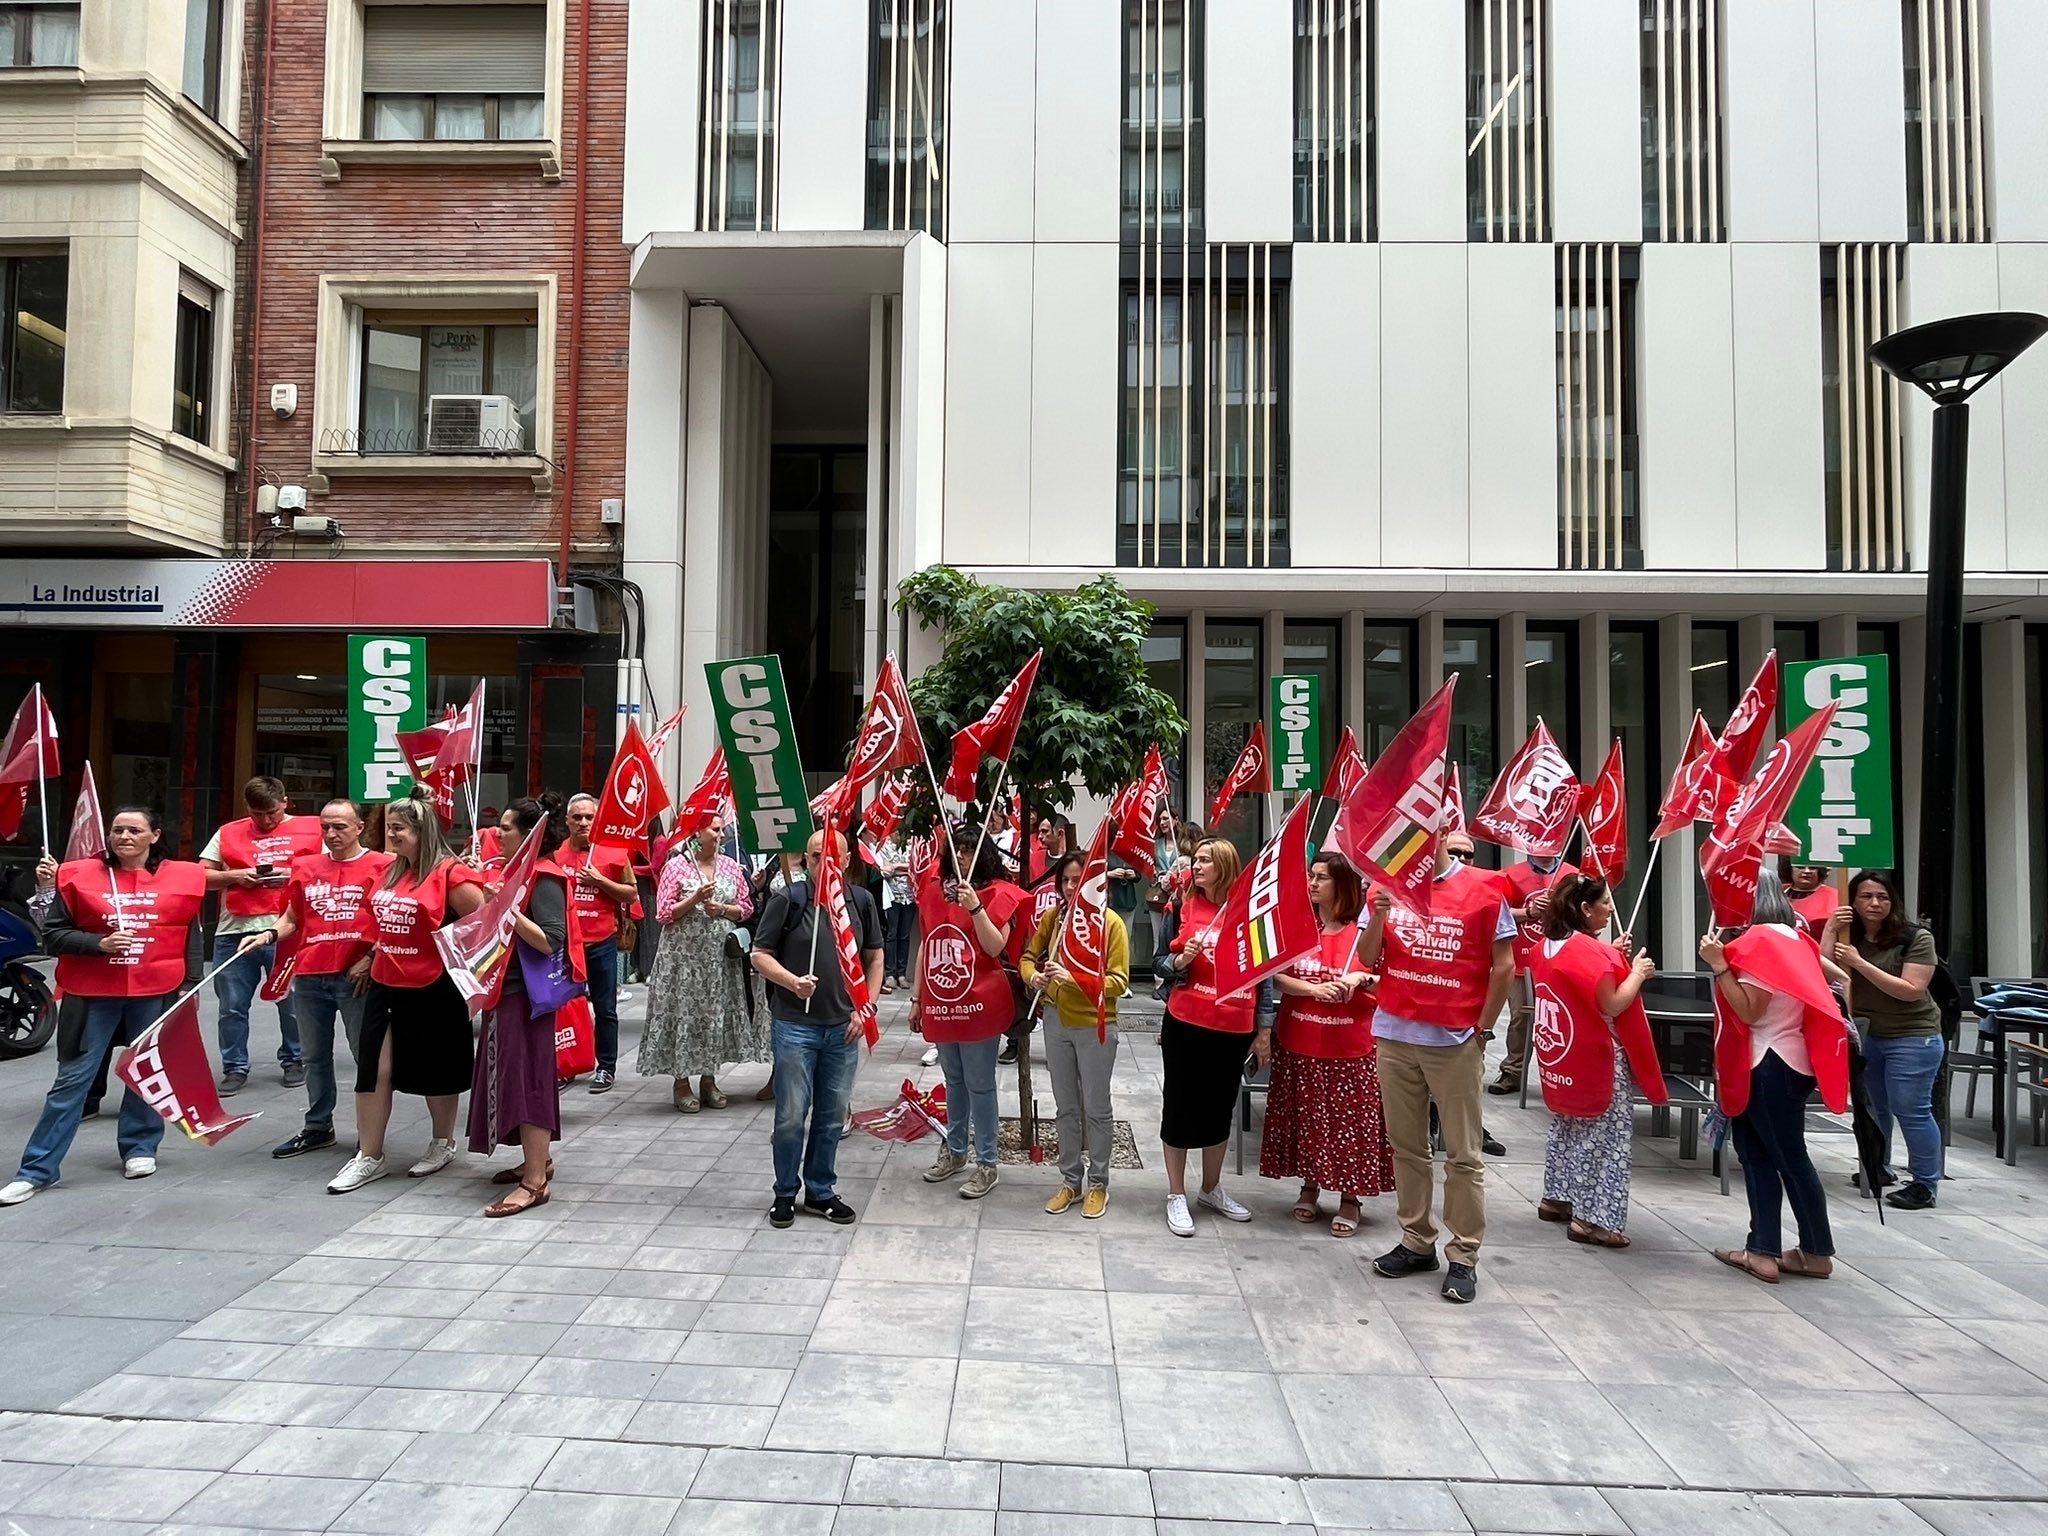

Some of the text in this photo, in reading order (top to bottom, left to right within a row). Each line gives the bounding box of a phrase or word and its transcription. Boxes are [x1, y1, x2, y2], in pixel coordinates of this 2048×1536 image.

[33, 585, 160, 602] La Industrial
[1440, 924, 1464, 938] tuyo
[928, 938, 966, 966] UGT
[1411, 946, 1454, 962] CCOO
[955, 1002, 984, 1014] mano
